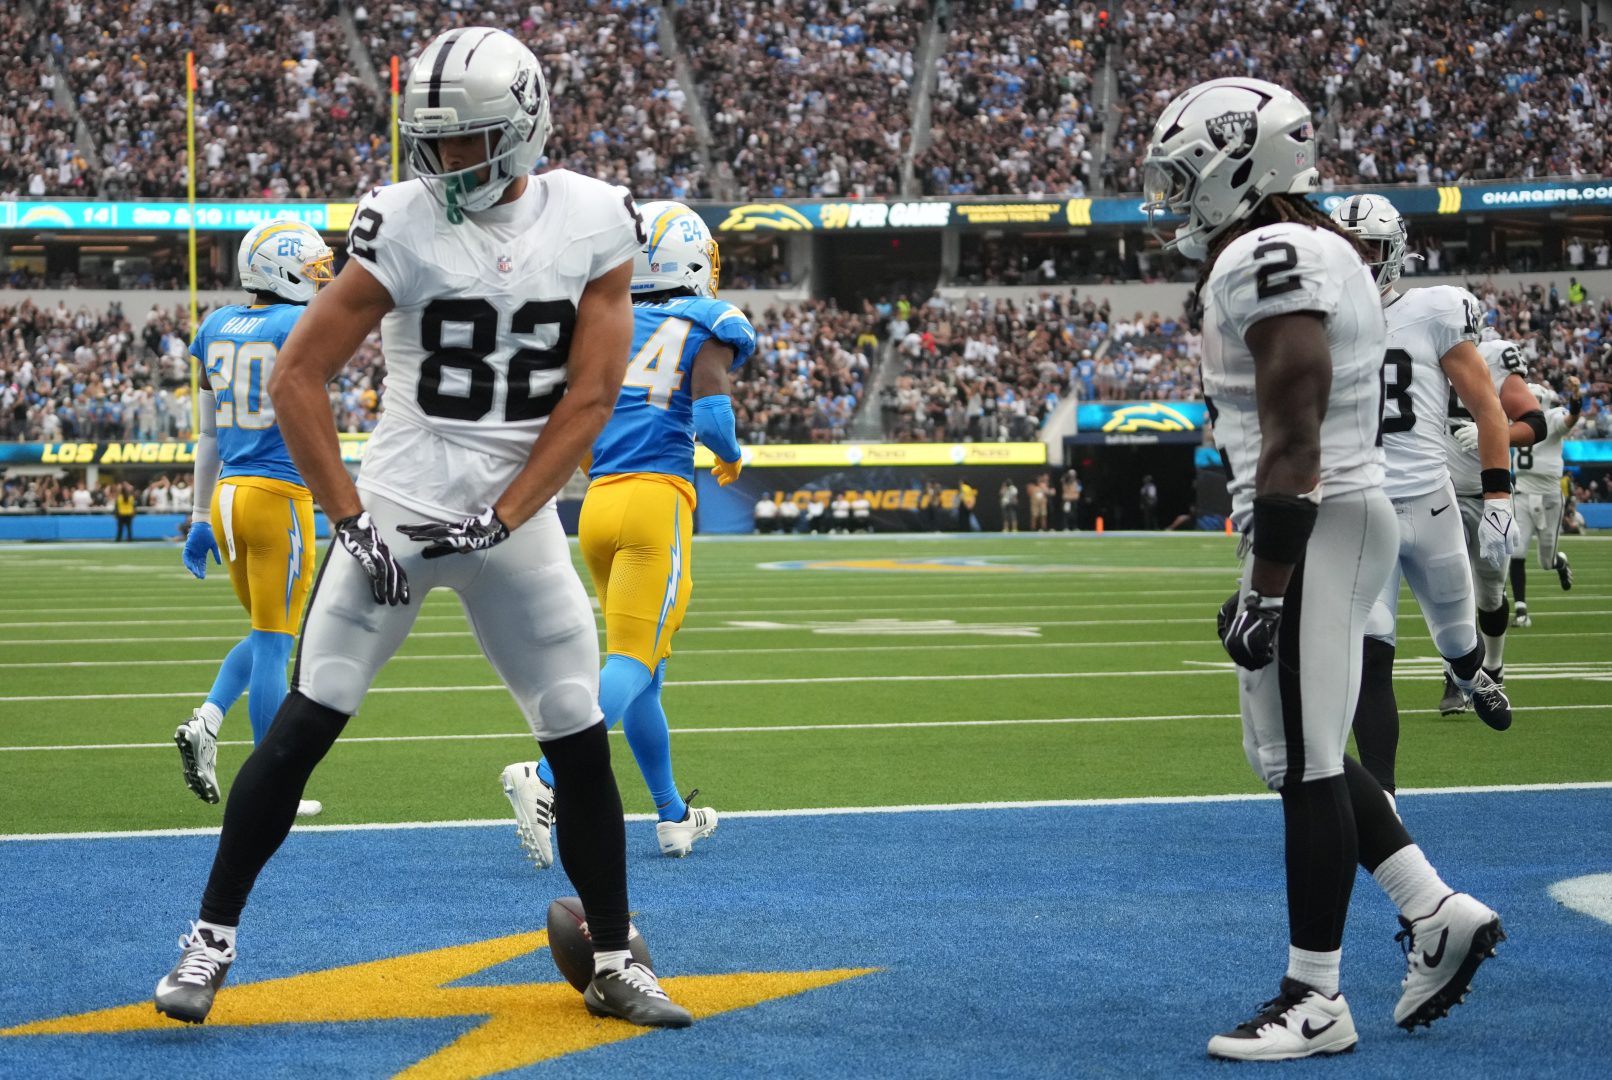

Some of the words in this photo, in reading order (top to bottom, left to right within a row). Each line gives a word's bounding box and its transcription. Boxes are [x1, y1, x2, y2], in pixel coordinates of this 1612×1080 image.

[1209, 112, 1252, 126] RAIDERS
[347, 204, 384, 264] 2
[680, 219, 702, 242] 24
[848, 203, 889, 228] PER
[889, 202, 951, 227] GAME
[1253, 241, 1302, 301] 2
[220, 316, 267, 334] HART
[416, 298, 577, 422] 82
[622, 316, 694, 411] 4
[206, 341, 279, 430] 20
[41, 443, 97, 463] LOS
[100, 442, 198, 464] ANGEL
